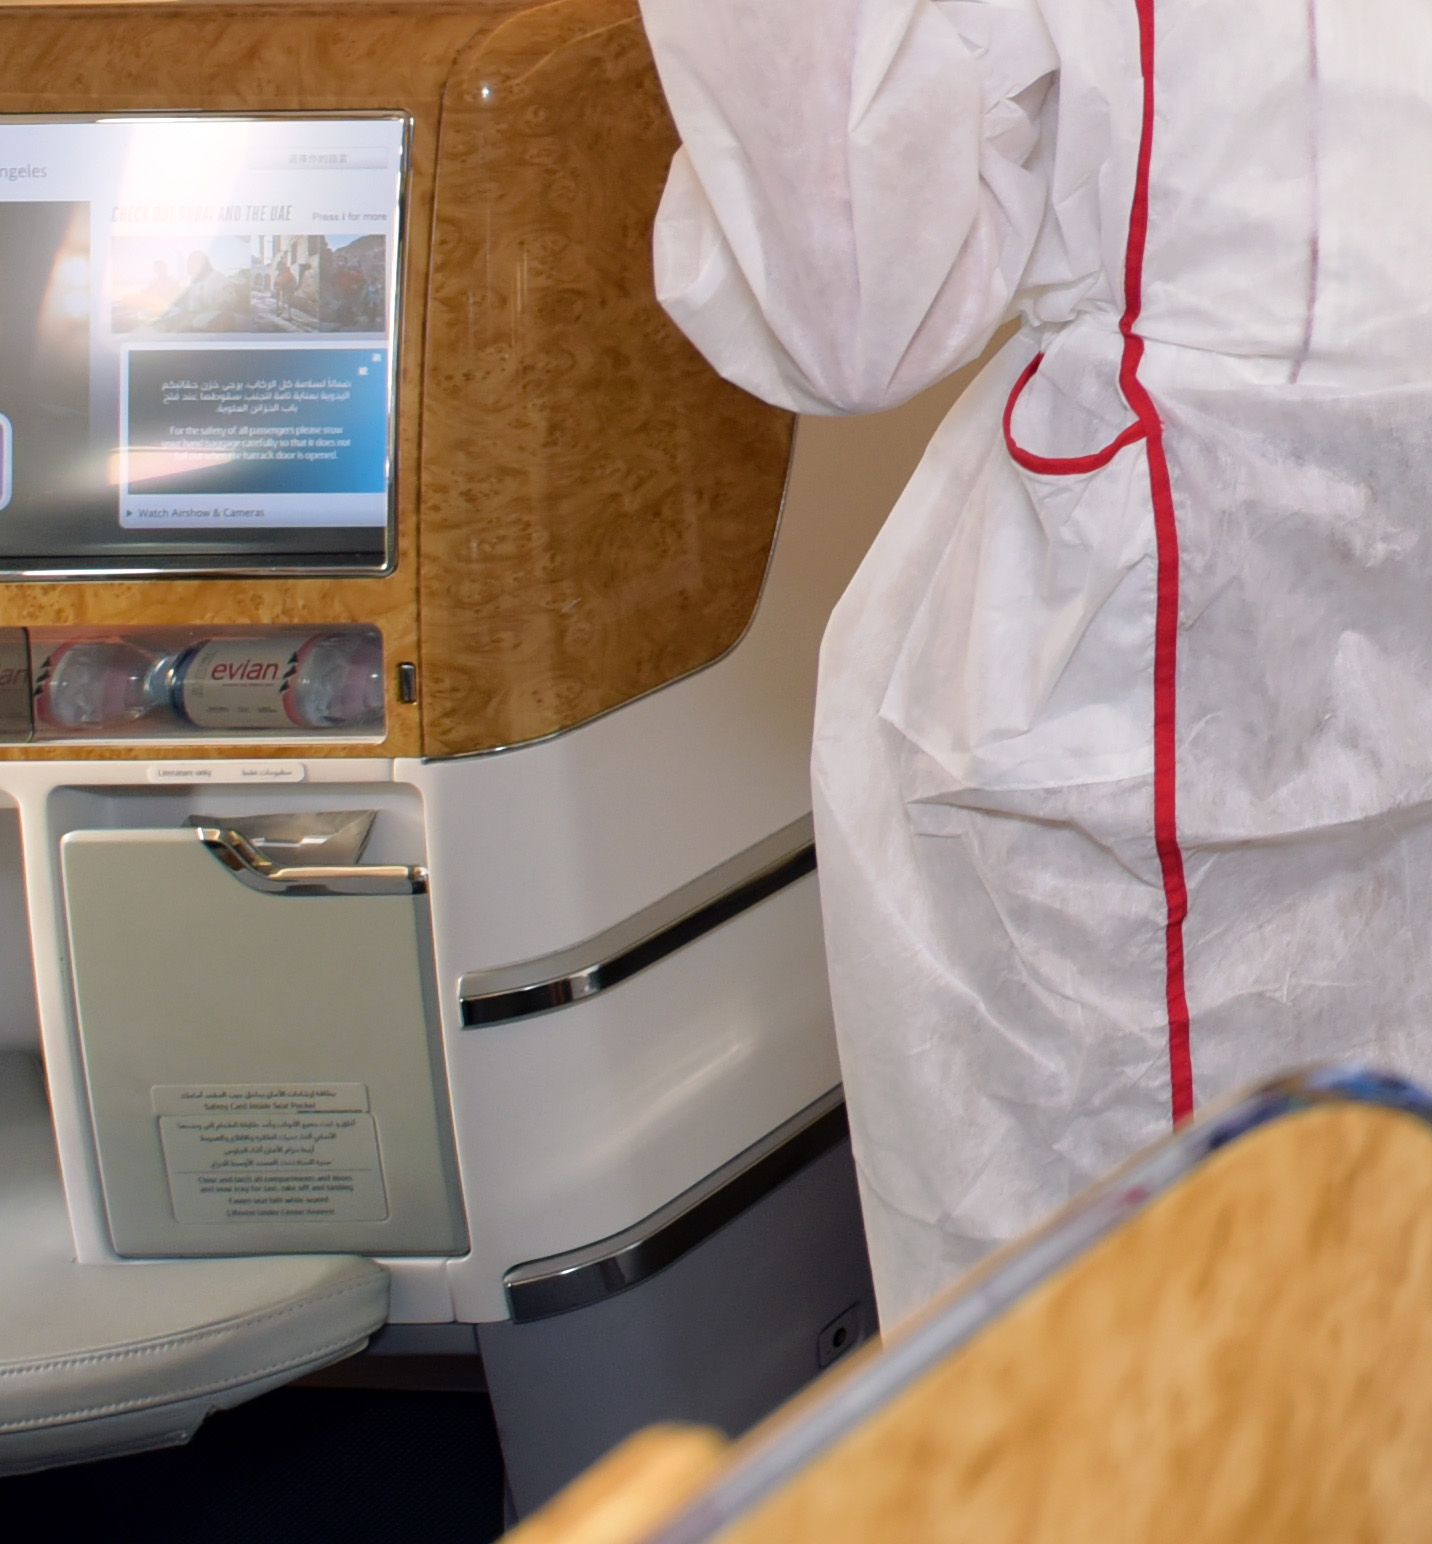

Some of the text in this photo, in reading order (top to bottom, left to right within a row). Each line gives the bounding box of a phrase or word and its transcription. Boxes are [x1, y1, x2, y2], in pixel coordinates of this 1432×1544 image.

[0, 165, 48, 181] ngeles
[312, 212, 338, 220] Press
[348, 212, 360, 220] for
[139, 508, 168, 517] Watch
[171, 508, 209, 517] Airshow
[224, 508, 264, 517] Cameras
[211, 659, 279, 681] evian
